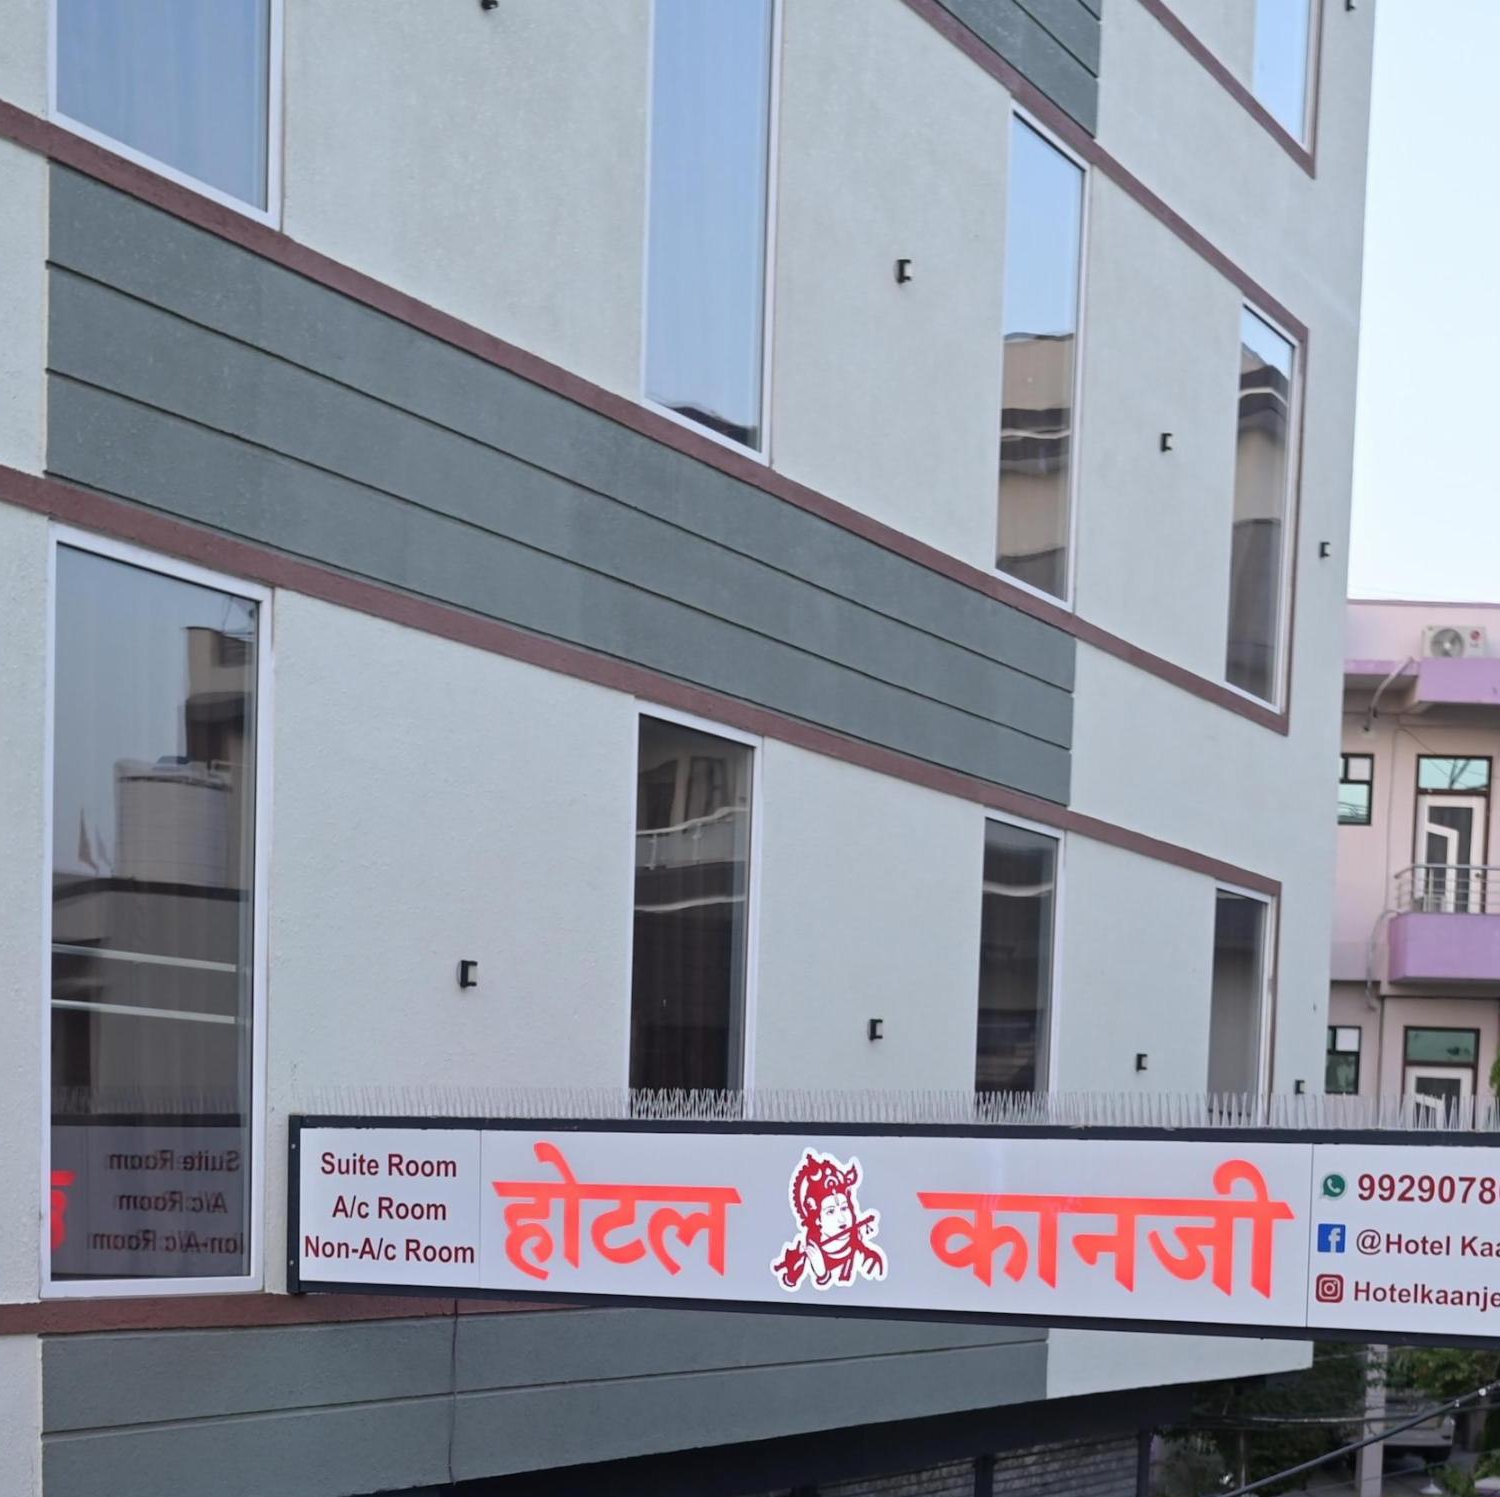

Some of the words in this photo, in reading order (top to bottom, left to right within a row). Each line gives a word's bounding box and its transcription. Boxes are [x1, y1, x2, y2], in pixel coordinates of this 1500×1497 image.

[320, 1151, 380, 1176] Suite
[388, 1152, 457, 1179] Room
[332, 1194, 370, 1219] A/c
[377, 1196, 448, 1221] Room
[491, 1141, 742, 1281] होटल
[916, 1159, 1295, 1299] कानजी
[303, 1235, 397, 1263] Non-A/c
[405, 1238, 475, 1265] Room
[1356, 1229, 1451, 1256] @Hotel
